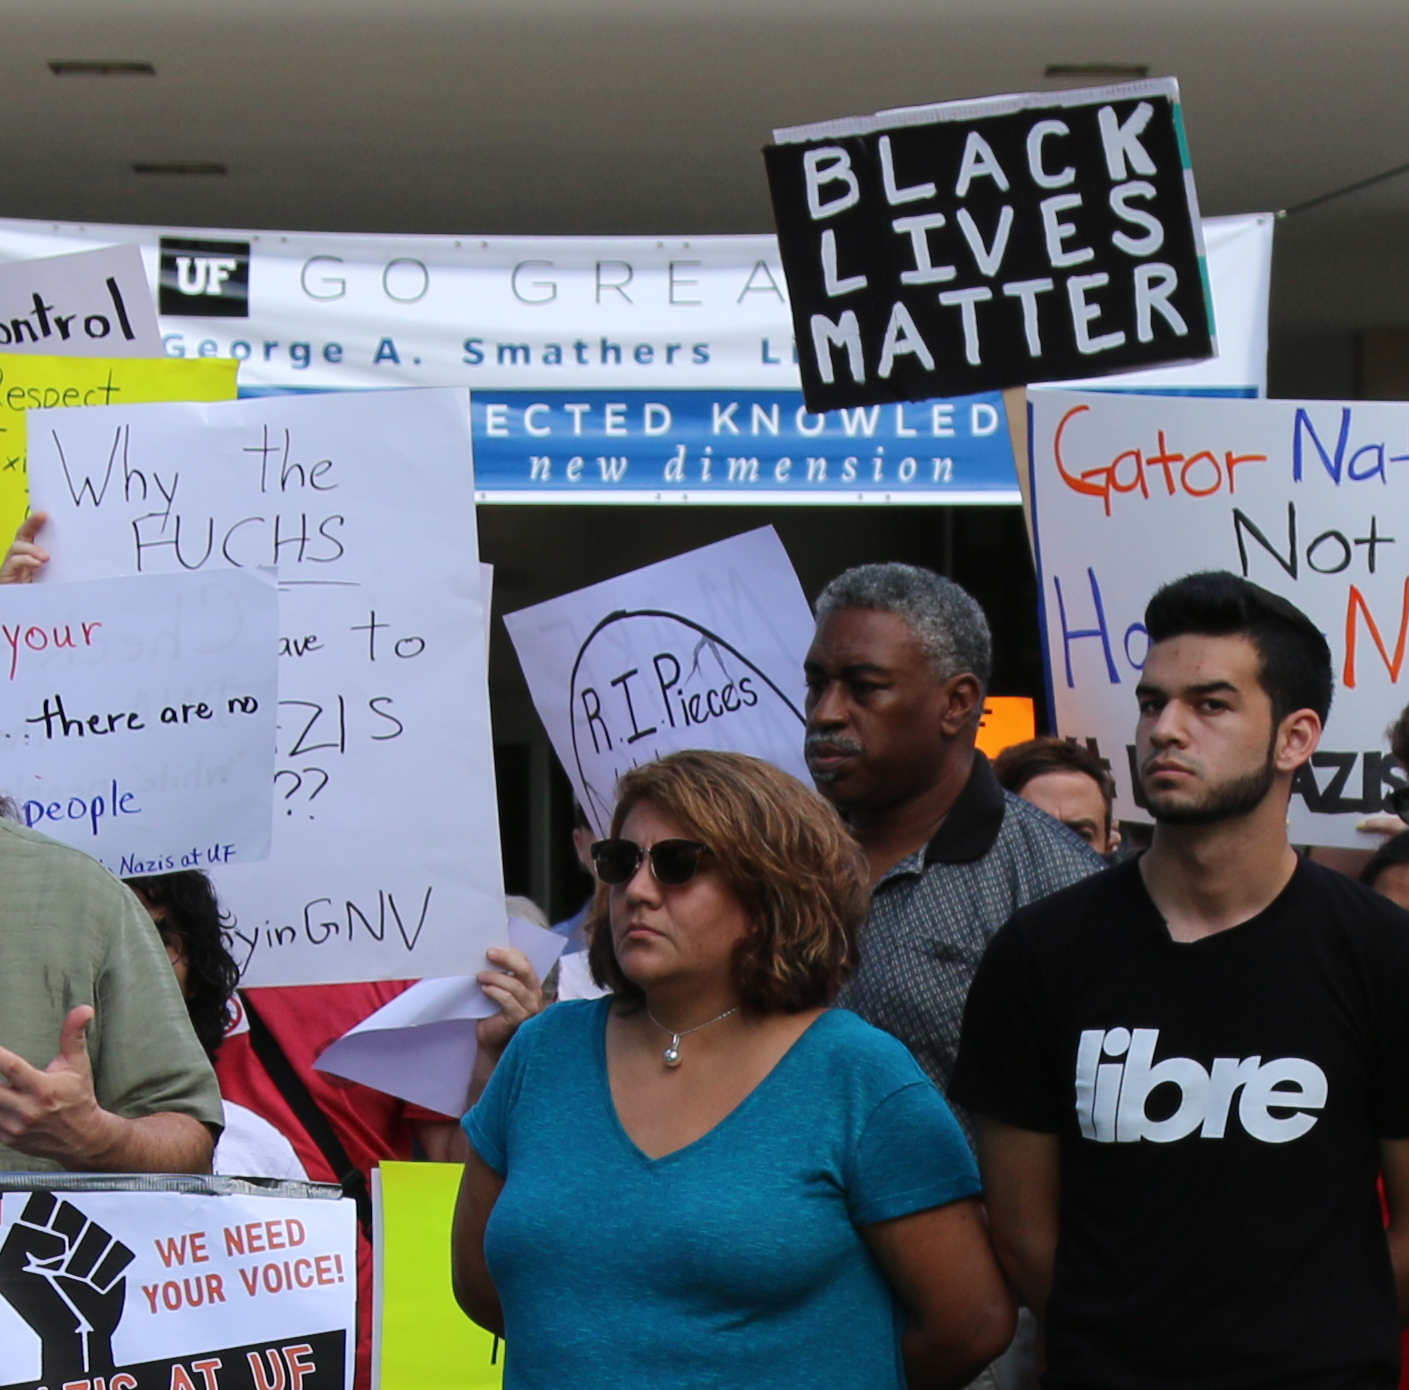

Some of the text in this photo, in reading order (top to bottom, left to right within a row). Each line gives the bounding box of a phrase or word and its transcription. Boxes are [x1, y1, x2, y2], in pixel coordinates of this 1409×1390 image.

[804, 101, 1157, 220] BLACK
[821, 180, 1165, 297] LIVES
[176, 256, 237, 296] UF
[300, 254, 430, 304] GO
[161, 333, 344, 367] George
[373, 336, 422, 365] A.
[463, 335, 712, 365] Smathers
[810, 262, 1189, 384] MATTER
[52, 424, 339, 534] Why the
[529, 445, 954, 483] new dimension
[1054, 405, 1409, 517] Gator Na
[131, 513, 345, 572] FUCHS
[1232, 501, 1395, 581] Not
[2, 618, 103, 680] your
[350, 610, 425, 661] to
[160, 702, 213, 725] are
[227, 695, 259, 716] no
[23, 779, 143, 836] people
[119, 853, 175, 876] Nazis
[181, 848, 203, 867] at
[207, 843, 237, 863] UF
[1075, 1026, 1328, 1144] libre
[154, 1218, 307, 1268] WE NEED
[140, 1253, 346, 1315] YOUR VOICE!
